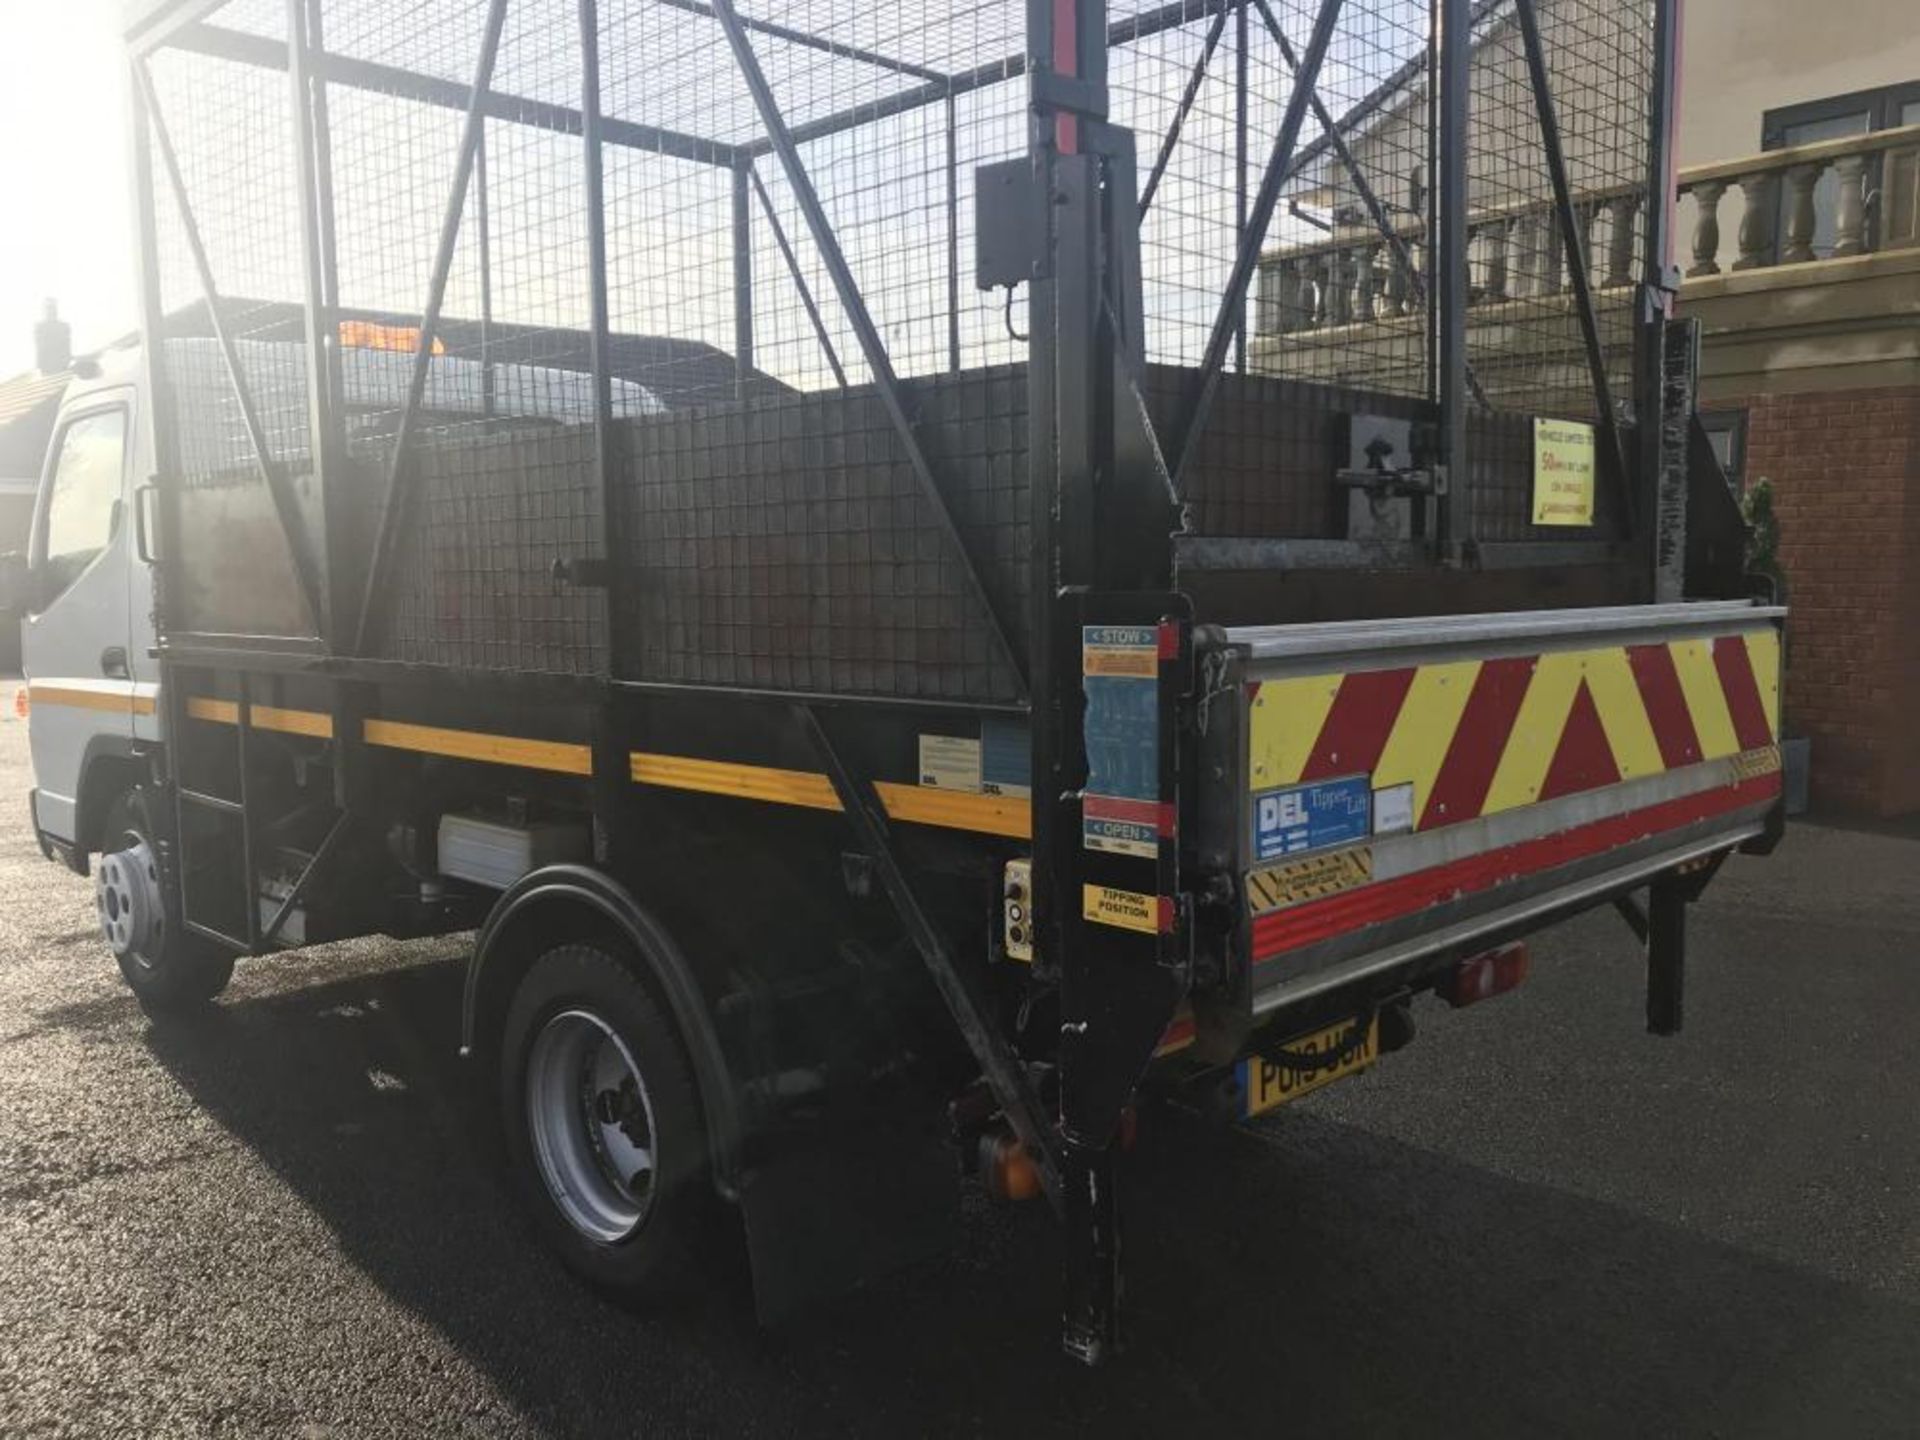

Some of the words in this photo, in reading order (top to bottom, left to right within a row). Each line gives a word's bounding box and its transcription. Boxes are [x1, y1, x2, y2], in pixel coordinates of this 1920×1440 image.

[1101, 629, 1140, 645] STOW
[1310, 787, 1348, 810] Tipper
[1346, 797, 1367, 816] Lift
[1259, 792, 1309, 833] DEL
[1104, 823, 1140, 840] OPEN
[1102, 889, 1145, 906] TIPPING
[1099, 900, 1149, 919] POSITION
